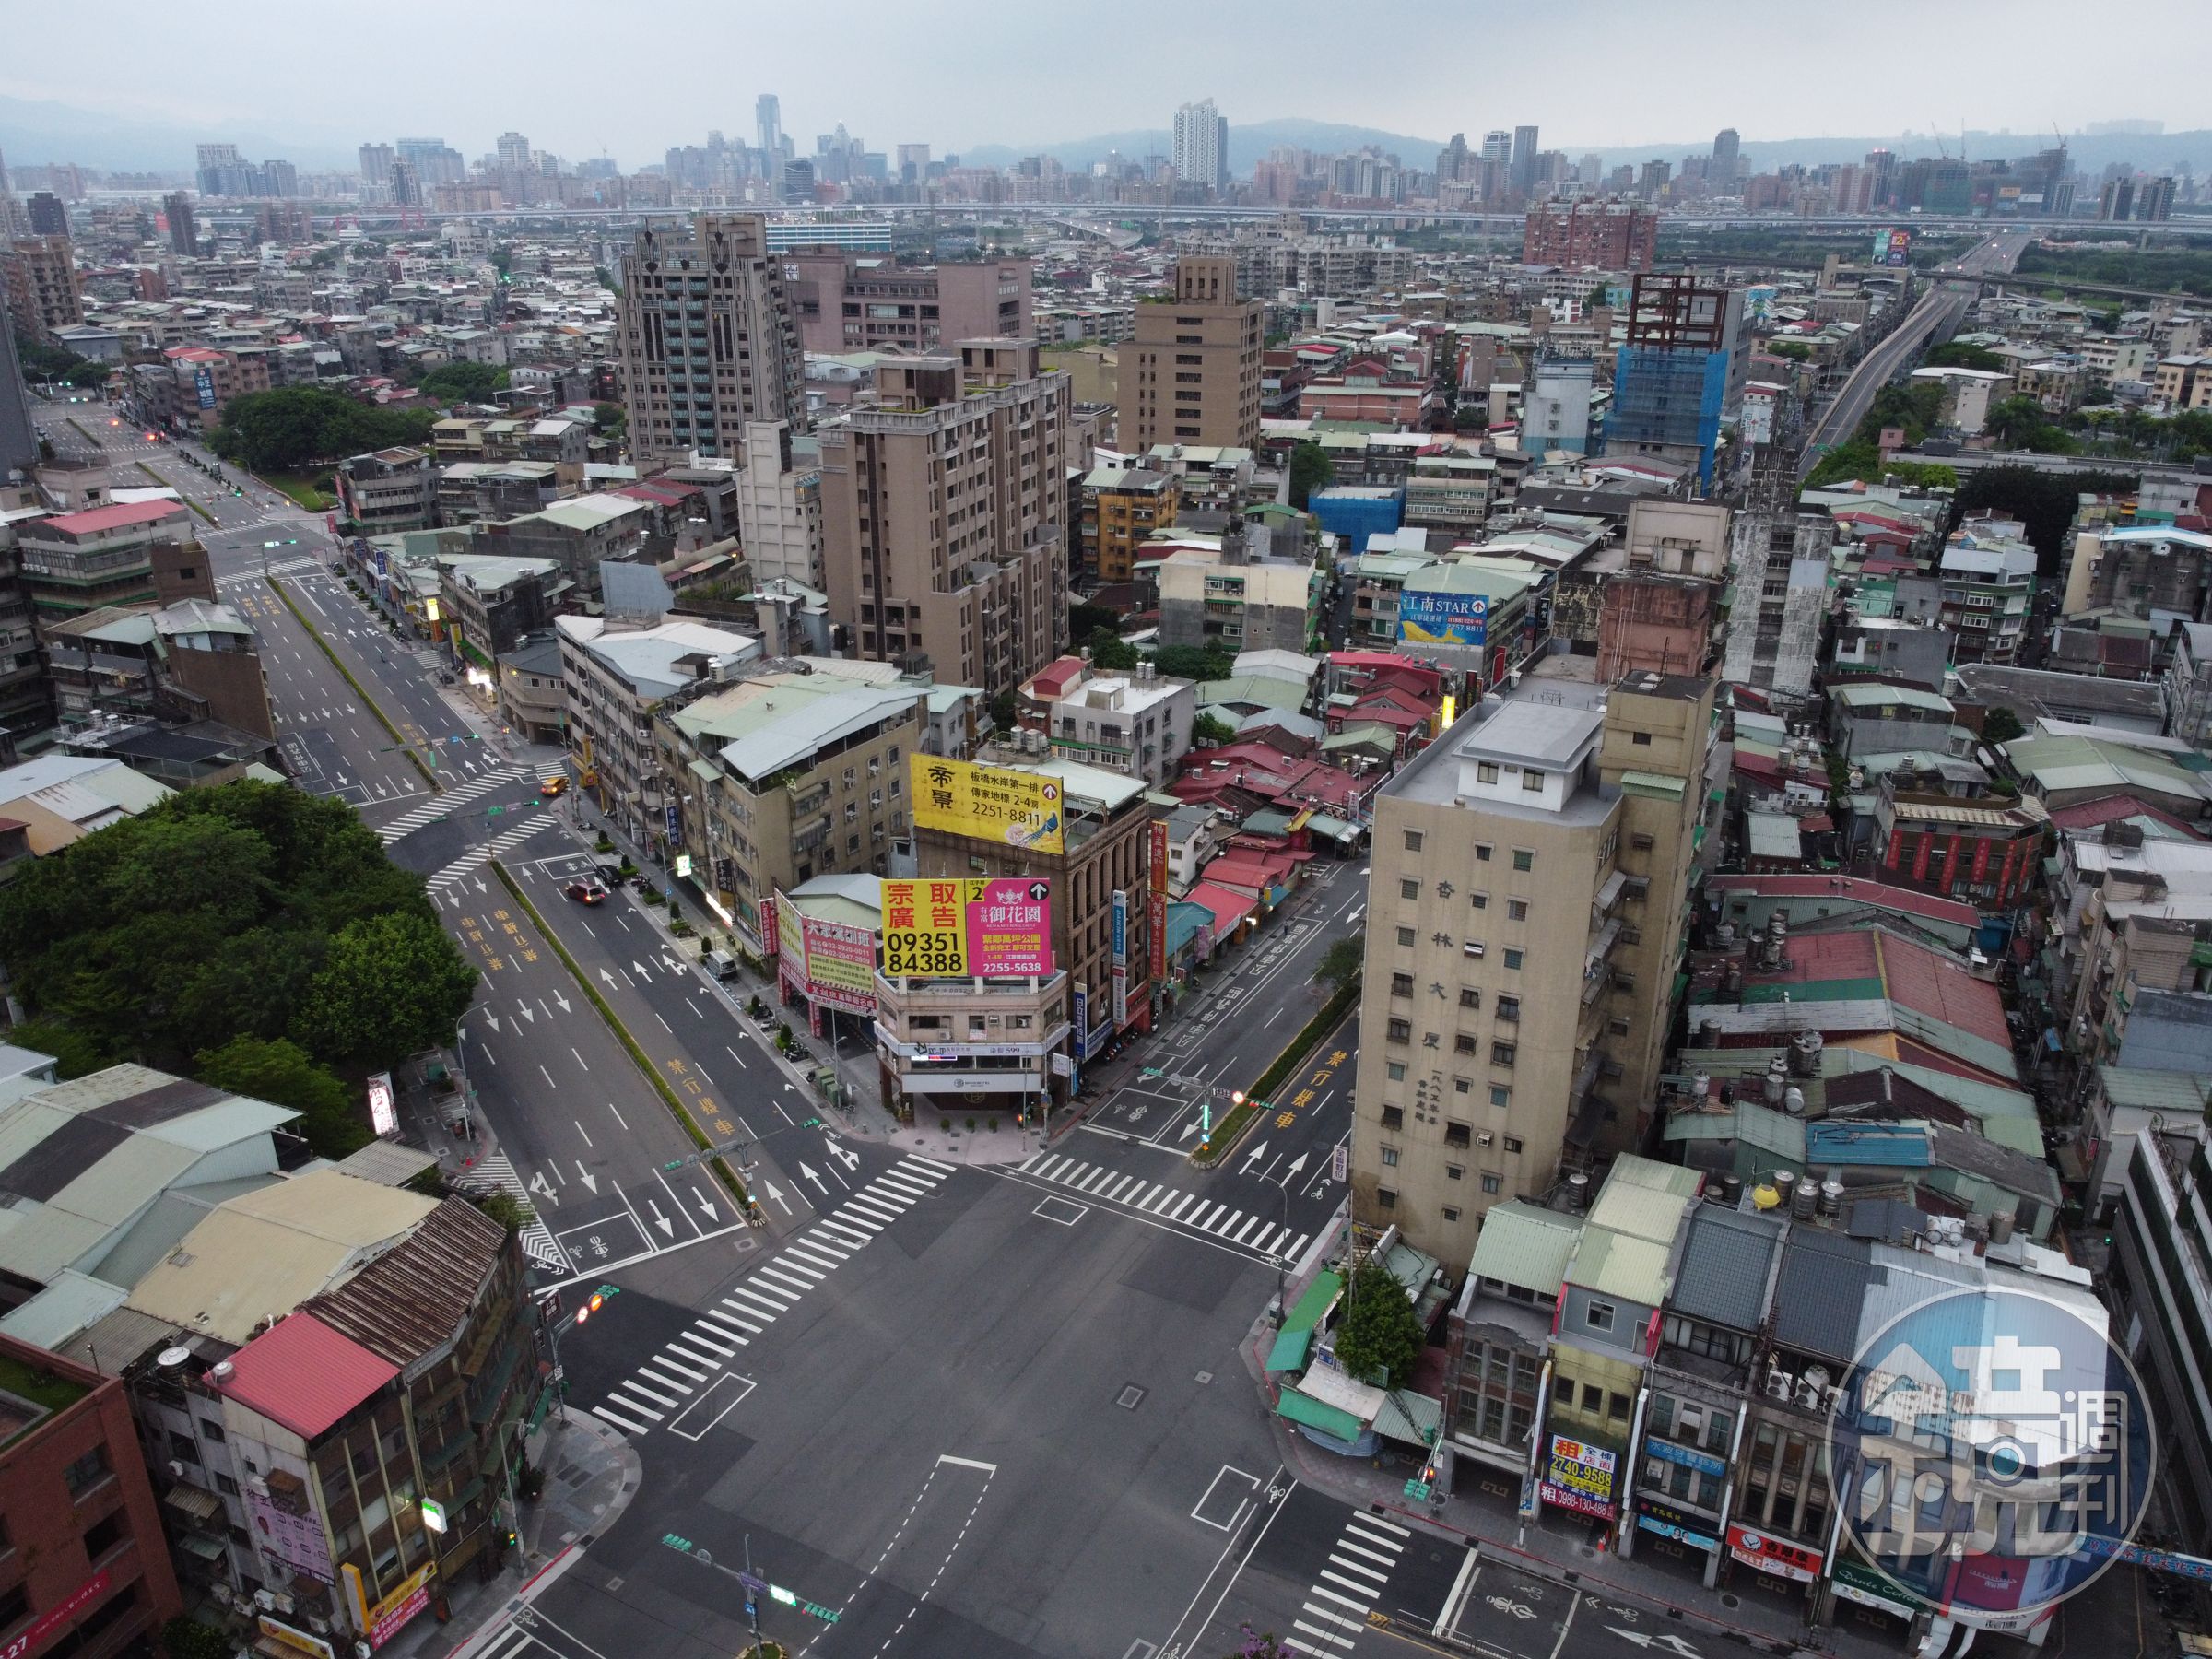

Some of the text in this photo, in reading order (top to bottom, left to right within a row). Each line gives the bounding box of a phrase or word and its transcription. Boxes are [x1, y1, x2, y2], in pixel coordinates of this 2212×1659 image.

[971, 771, 1039, 794] 板橋水岸第一排
[971, 787, 1010, 804] 傳家地標
[972, 802, 1040, 826] 2251-8811
[972, 887, 983, 900] 2
[990, 906, 1041, 923] 御花園
[888, 933, 959, 952] 09351
[889, 953, 962, 972] 84388
[982, 963, 1041, 972] 2255-5638
[667, 1059, 735, 1135] 禁行機車
[1274, 1050, 1347, 1128] 禁行機車
[1555, 1439, 1579, 1460] 租
[1550, 1455, 1612, 1486] 2740-9588
[1541, 1486, 1556, 1501] 租
